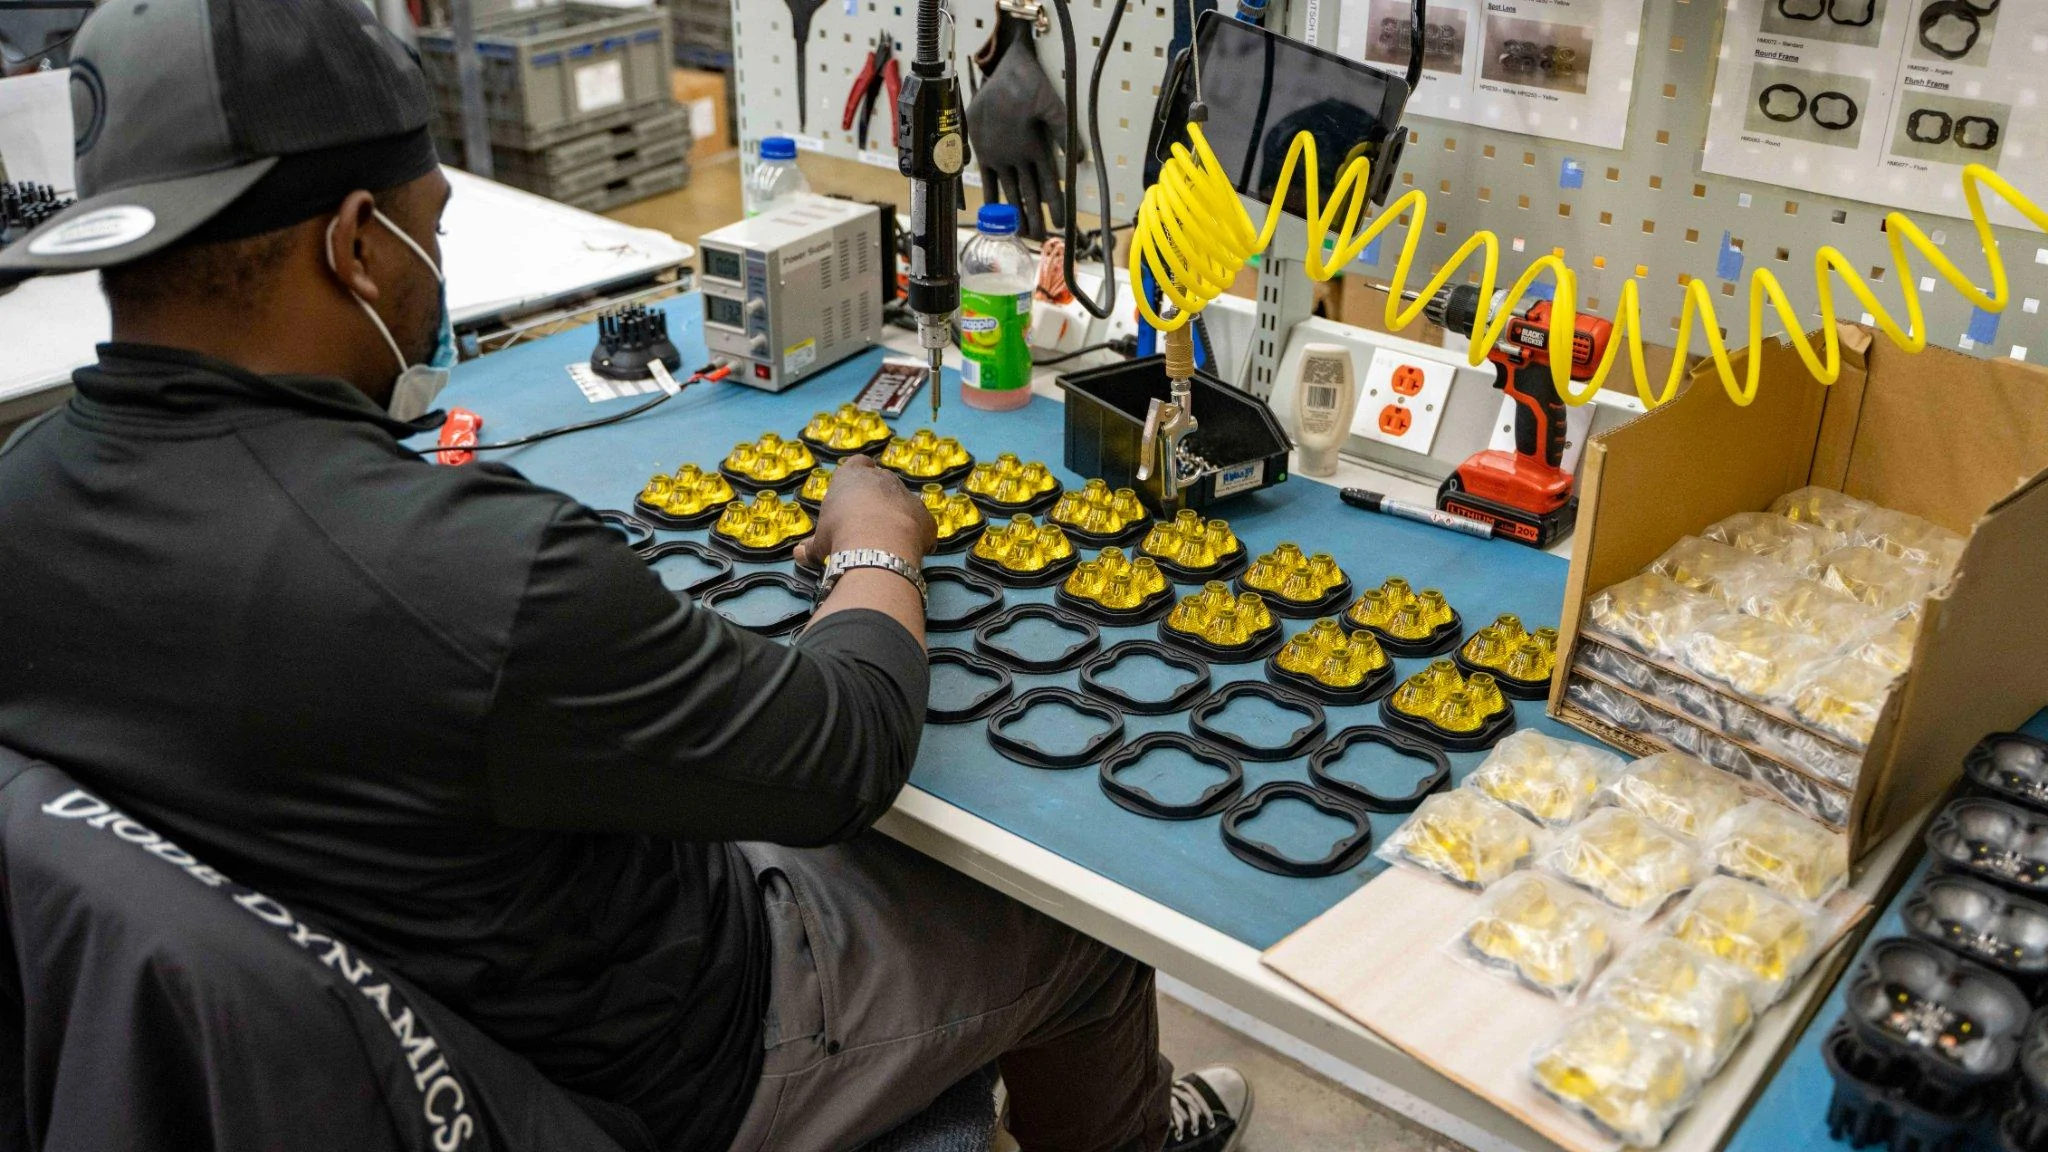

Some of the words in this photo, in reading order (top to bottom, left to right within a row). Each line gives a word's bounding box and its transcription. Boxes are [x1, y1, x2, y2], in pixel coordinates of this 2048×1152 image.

[1755, 49, 1777, 58] Round
[1778, 52, 1799, 62] Frame
[1904, 76, 1925, 86] Flush
[1927, 79, 1949, 90] Frame
[783, 251, 806, 266] Power
[1520, 336, 1543, 347] DECKER
[1450, 505, 1495, 525] LITHIUM
[41, 789, 231, 888] DIODE
[233, 892, 474, 1152] DYNAMICS
